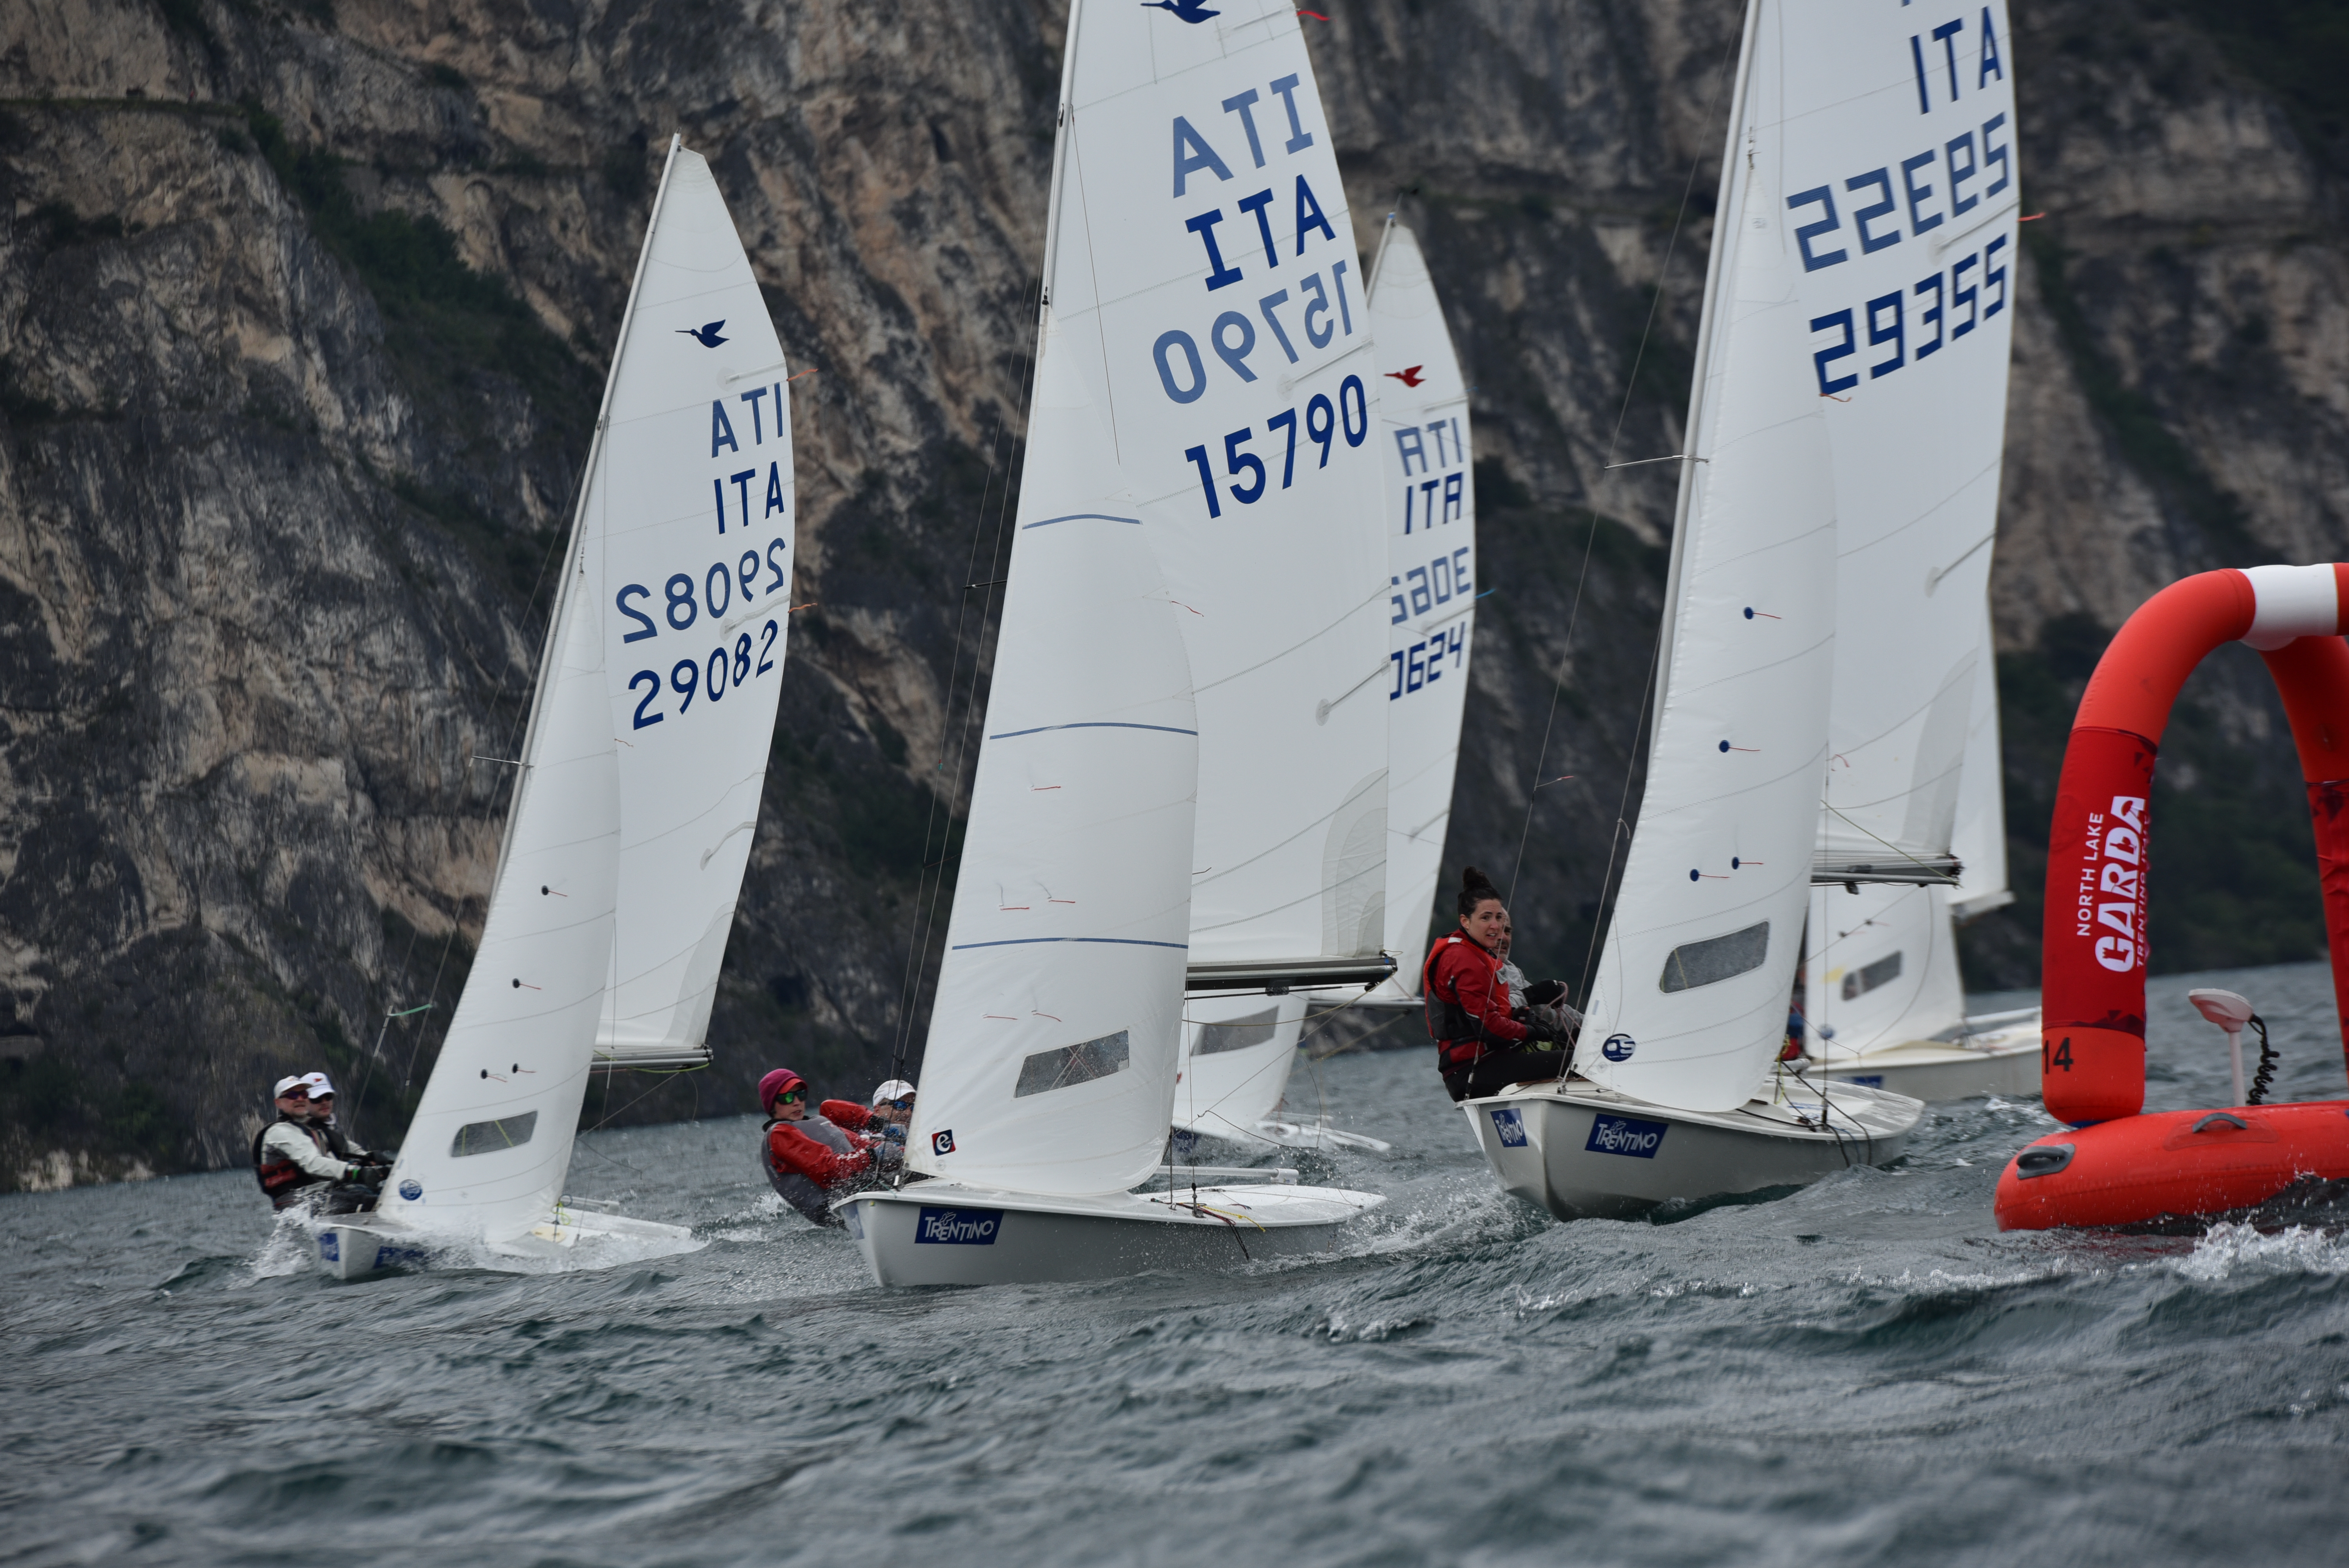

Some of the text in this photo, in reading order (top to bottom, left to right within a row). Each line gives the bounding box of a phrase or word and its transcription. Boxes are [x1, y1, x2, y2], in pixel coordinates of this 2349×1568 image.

[1911, 6, 2004, 115] ITA
[1185, 174, 1336, 292] ITA
[1809, 233, 2009, 396] 29355
[1185, 374, 1368, 519] 15790
[714, 461, 784, 534] ITA
[1405, 472, 1464, 534] ITA
[628, 619, 778, 730] 29082
[1390, 622, 1465, 700] 0624
[2077, 812, 2104, 936] NORTH LAKE
[2095, 796, 2147, 972] GARDA
[2042, 1037, 2074, 1074] 14
[1495, 1119, 1523, 1144] TRENTINO
[1595, 1123, 1657, 1152] TRENTINO
[925, 1216, 995, 1241] TRENTINO
